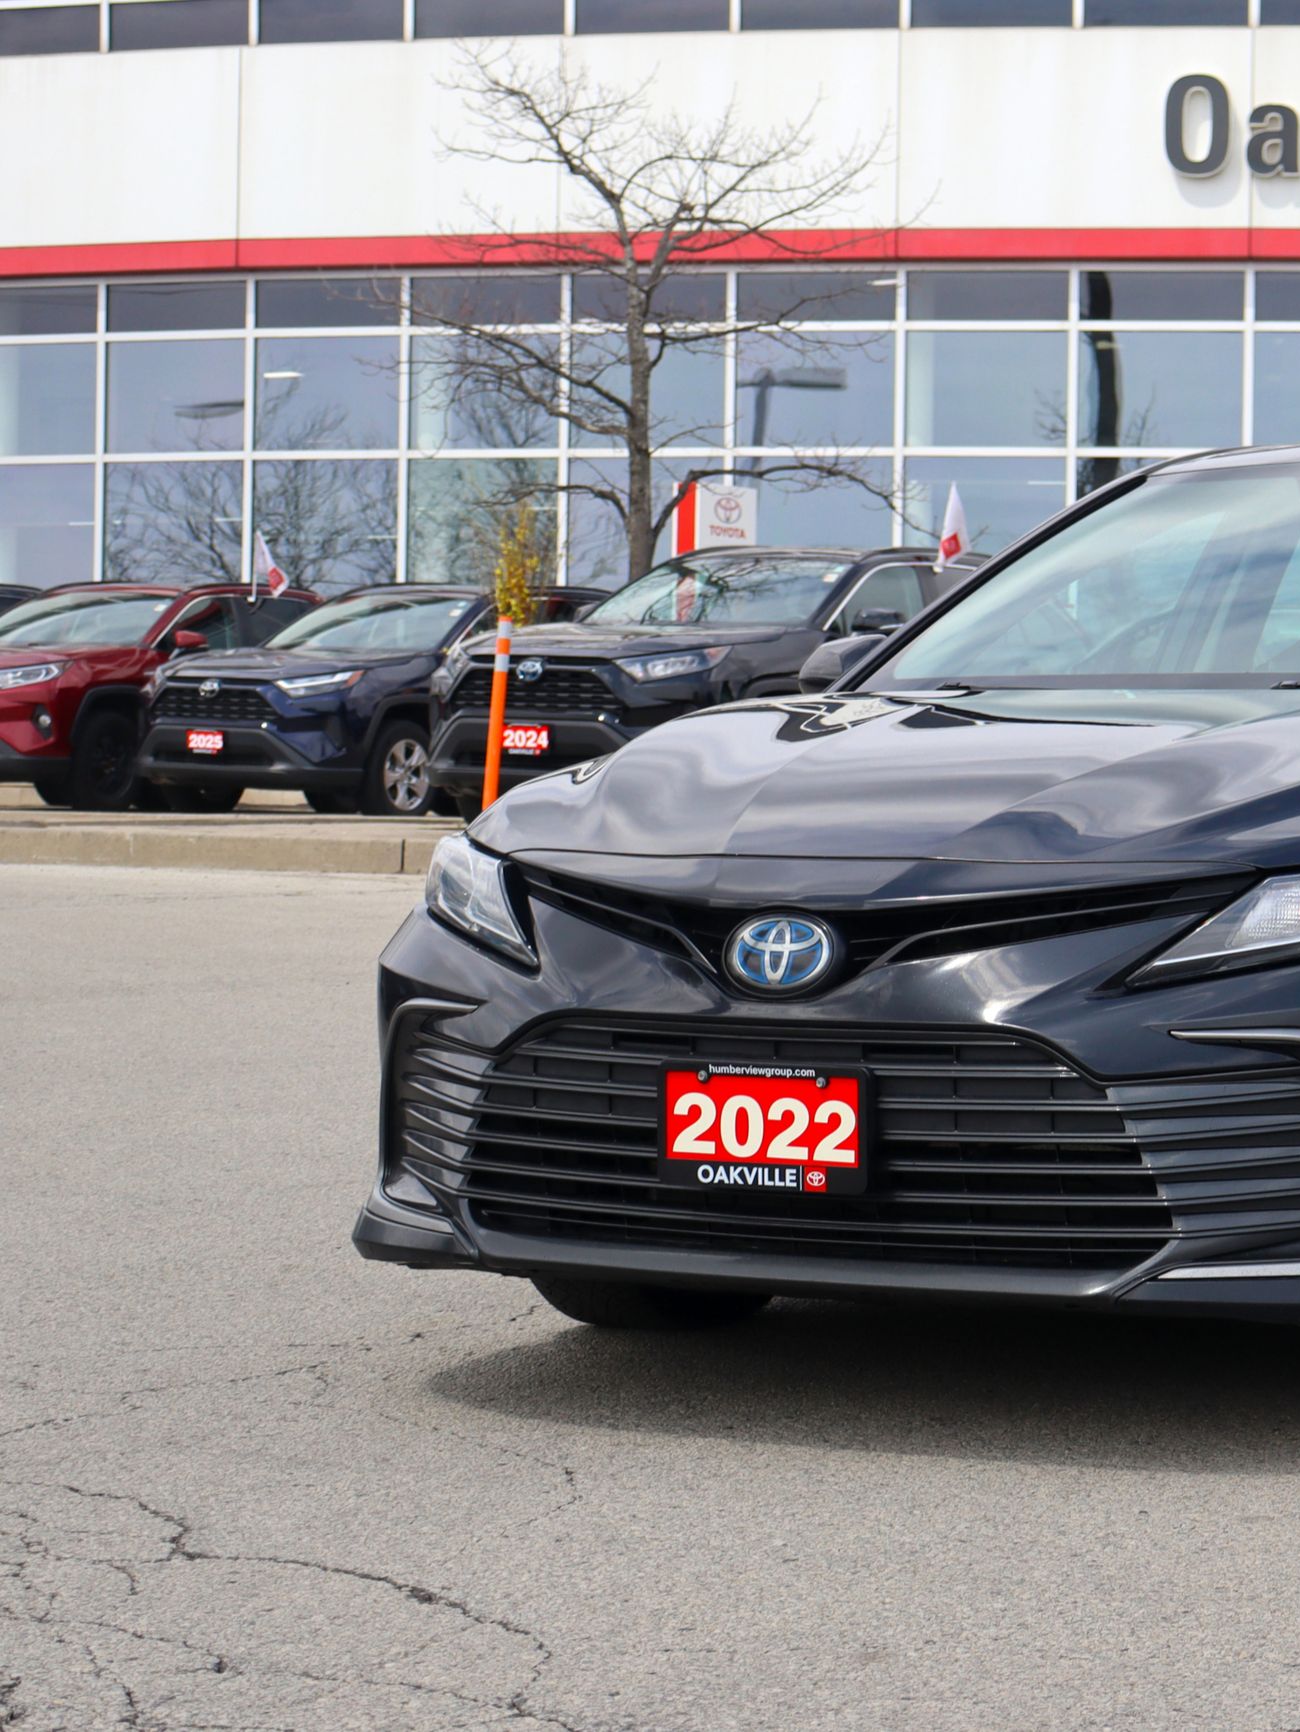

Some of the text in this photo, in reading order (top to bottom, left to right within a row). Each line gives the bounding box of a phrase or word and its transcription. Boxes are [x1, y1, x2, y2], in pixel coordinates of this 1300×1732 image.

[709, 525, 746, 539] TOYOTA
[188, 733, 223, 749] 2025
[503, 729, 549, 748] 2024
[708, 1064, 816, 1078] humberviewgroup.com
[672, 1092, 856, 1163] 2022
[697, 1164, 797, 1187] OAKVILLE
